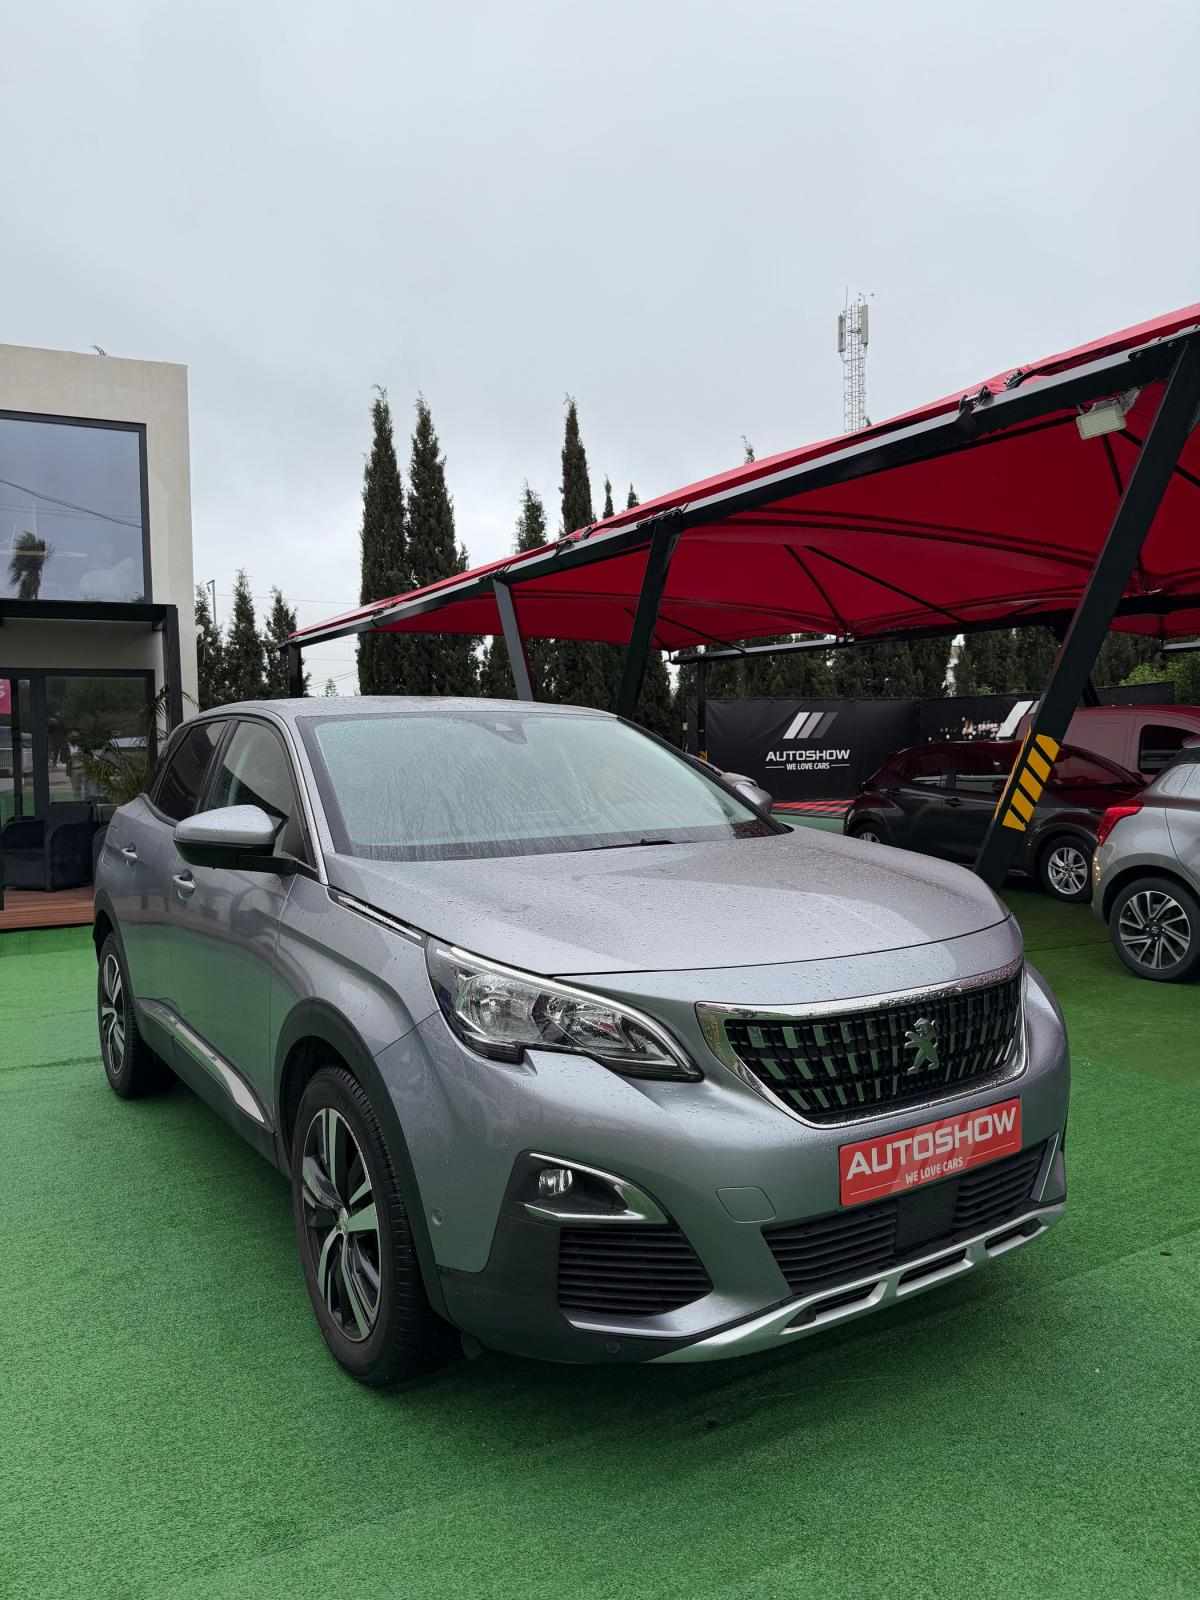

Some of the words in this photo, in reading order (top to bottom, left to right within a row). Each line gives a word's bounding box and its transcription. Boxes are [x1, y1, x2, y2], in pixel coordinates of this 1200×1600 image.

[765, 749, 850, 761] AUTOSHOW
[786, 763, 796, 771] WE
[814, 762, 830, 770] CARS
[846, 1107, 1016, 1181] AUTOSHOW
[905, 1172, 919, 1185] WE
[920, 1165, 943, 1180] LOVE
[943, 1157, 964, 1172] CARS
